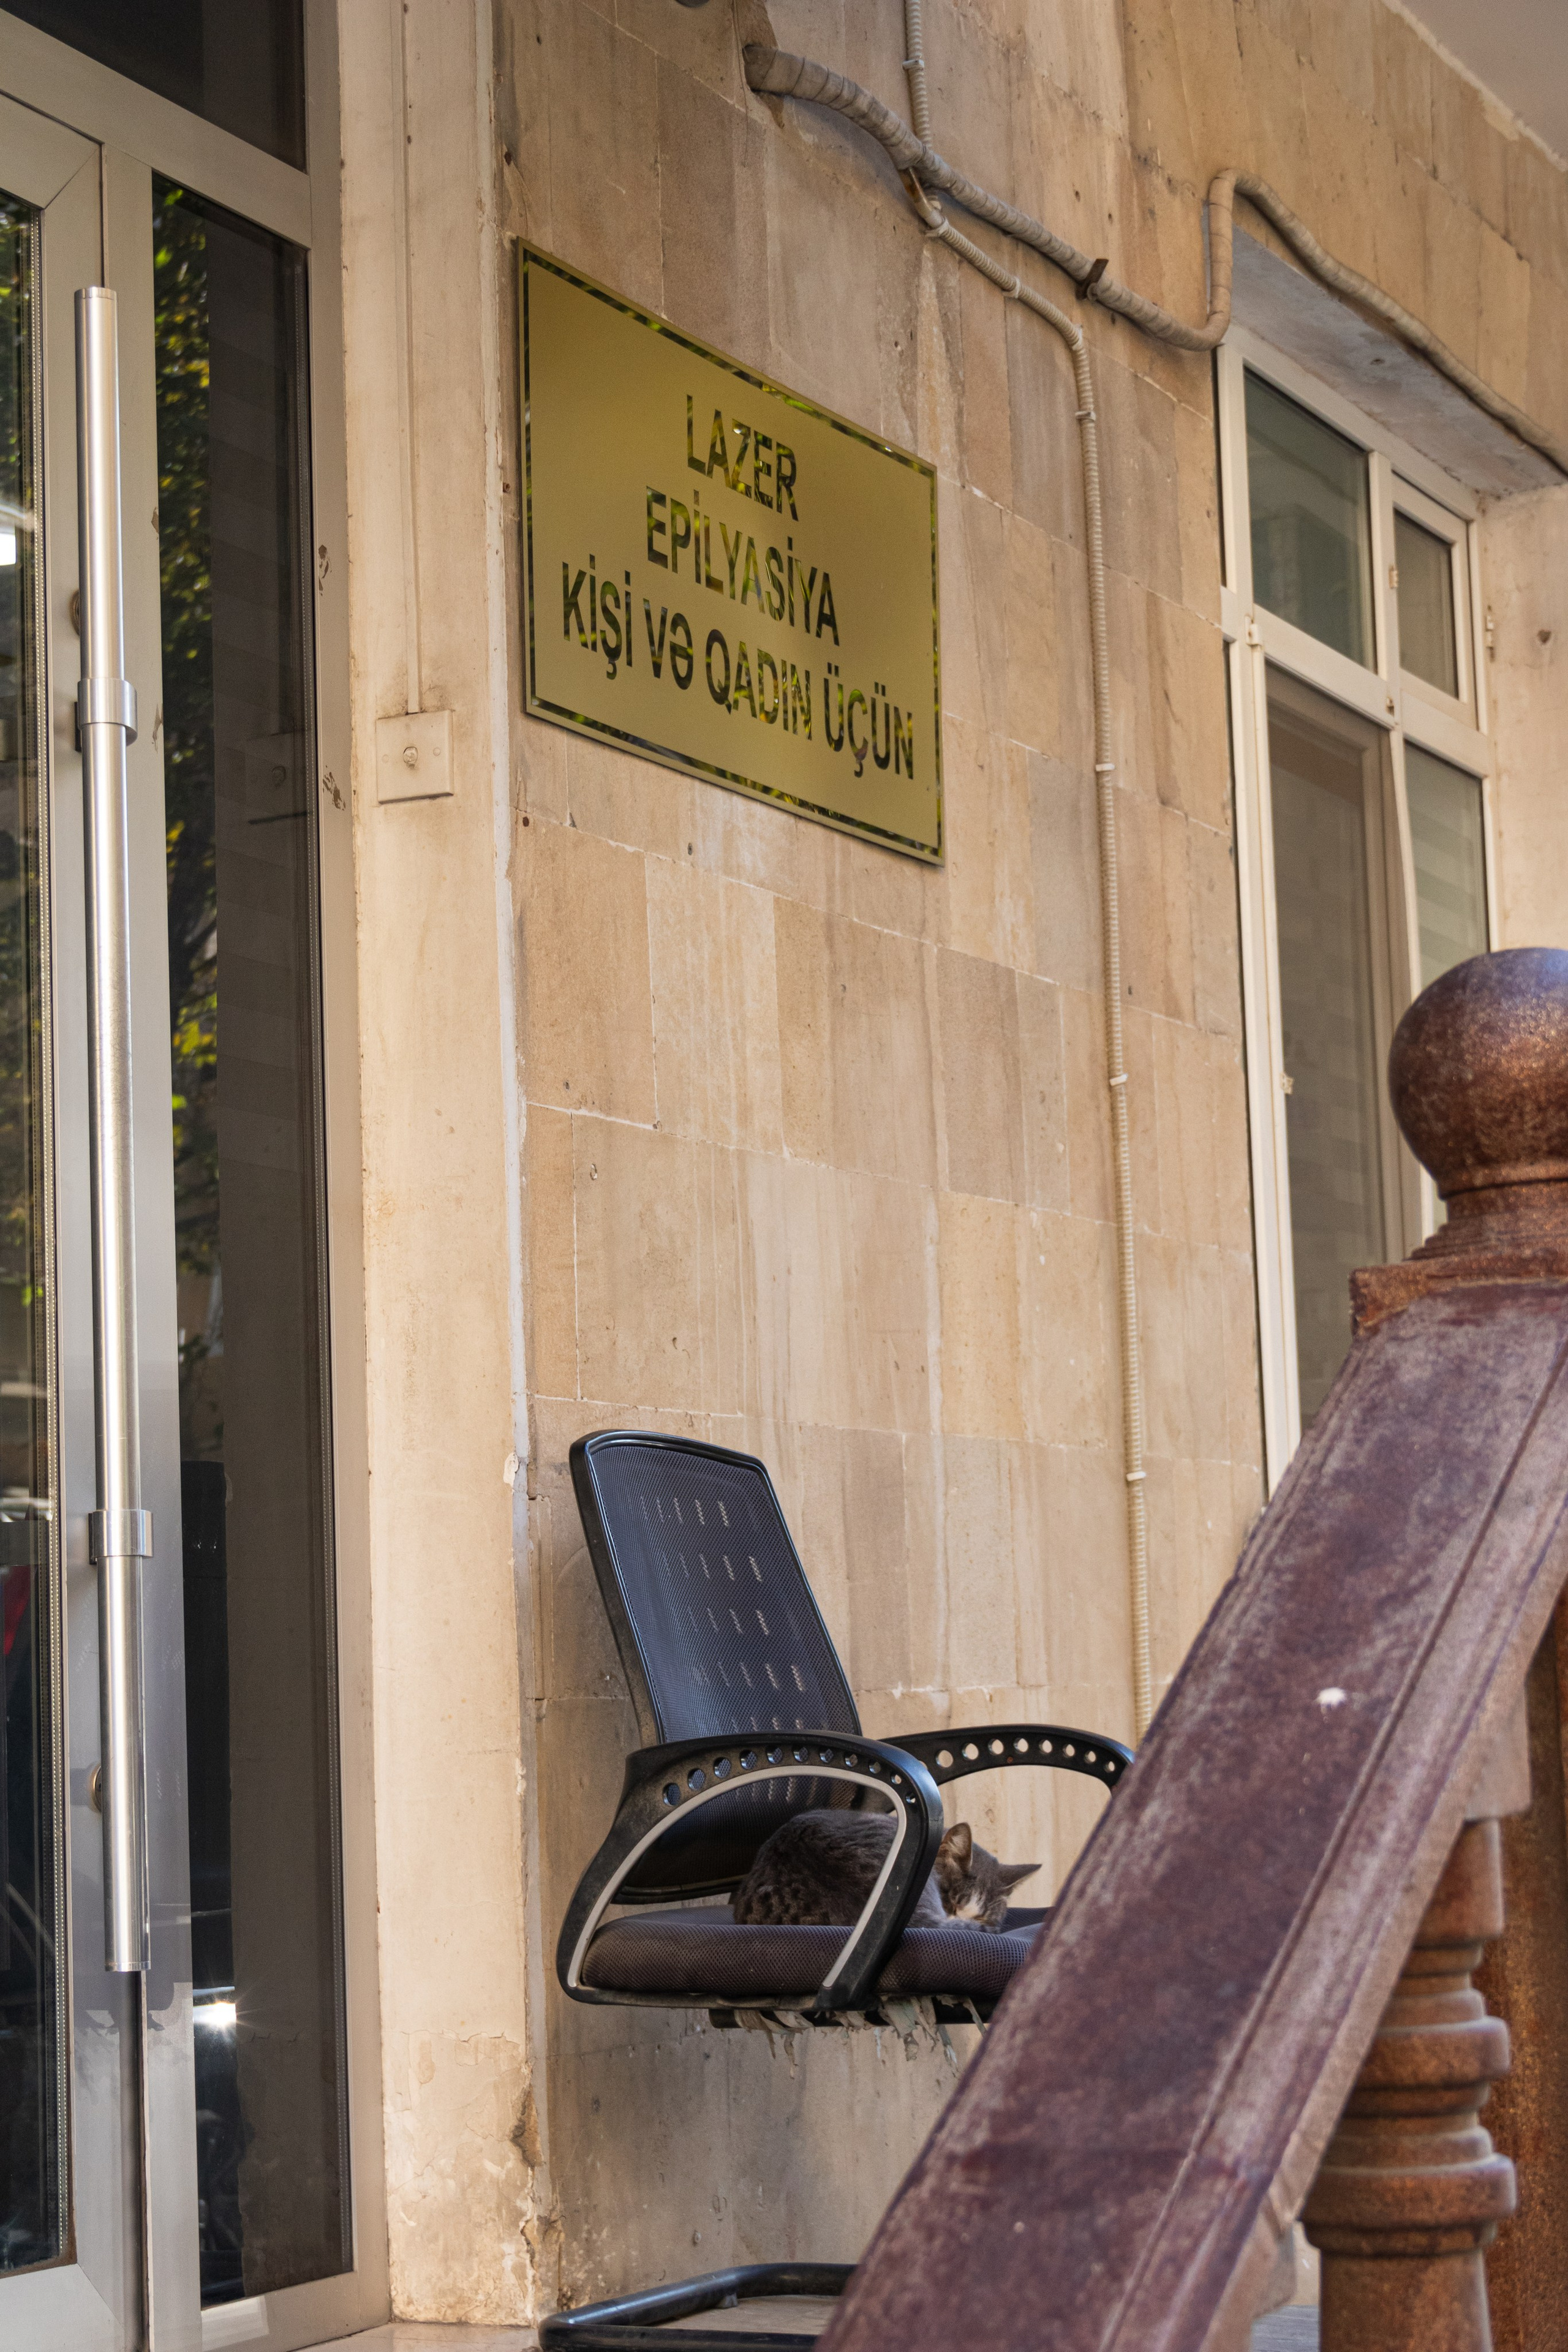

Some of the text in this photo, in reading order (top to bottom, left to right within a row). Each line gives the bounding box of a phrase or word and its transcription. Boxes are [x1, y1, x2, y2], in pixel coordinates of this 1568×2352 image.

[687, 394, 799, 521] LAZER
[646, 485, 840, 647] EPİLYASİYA
[562, 553, 914, 780] KİŞİ VƏ QADIN ÜÇÜN
